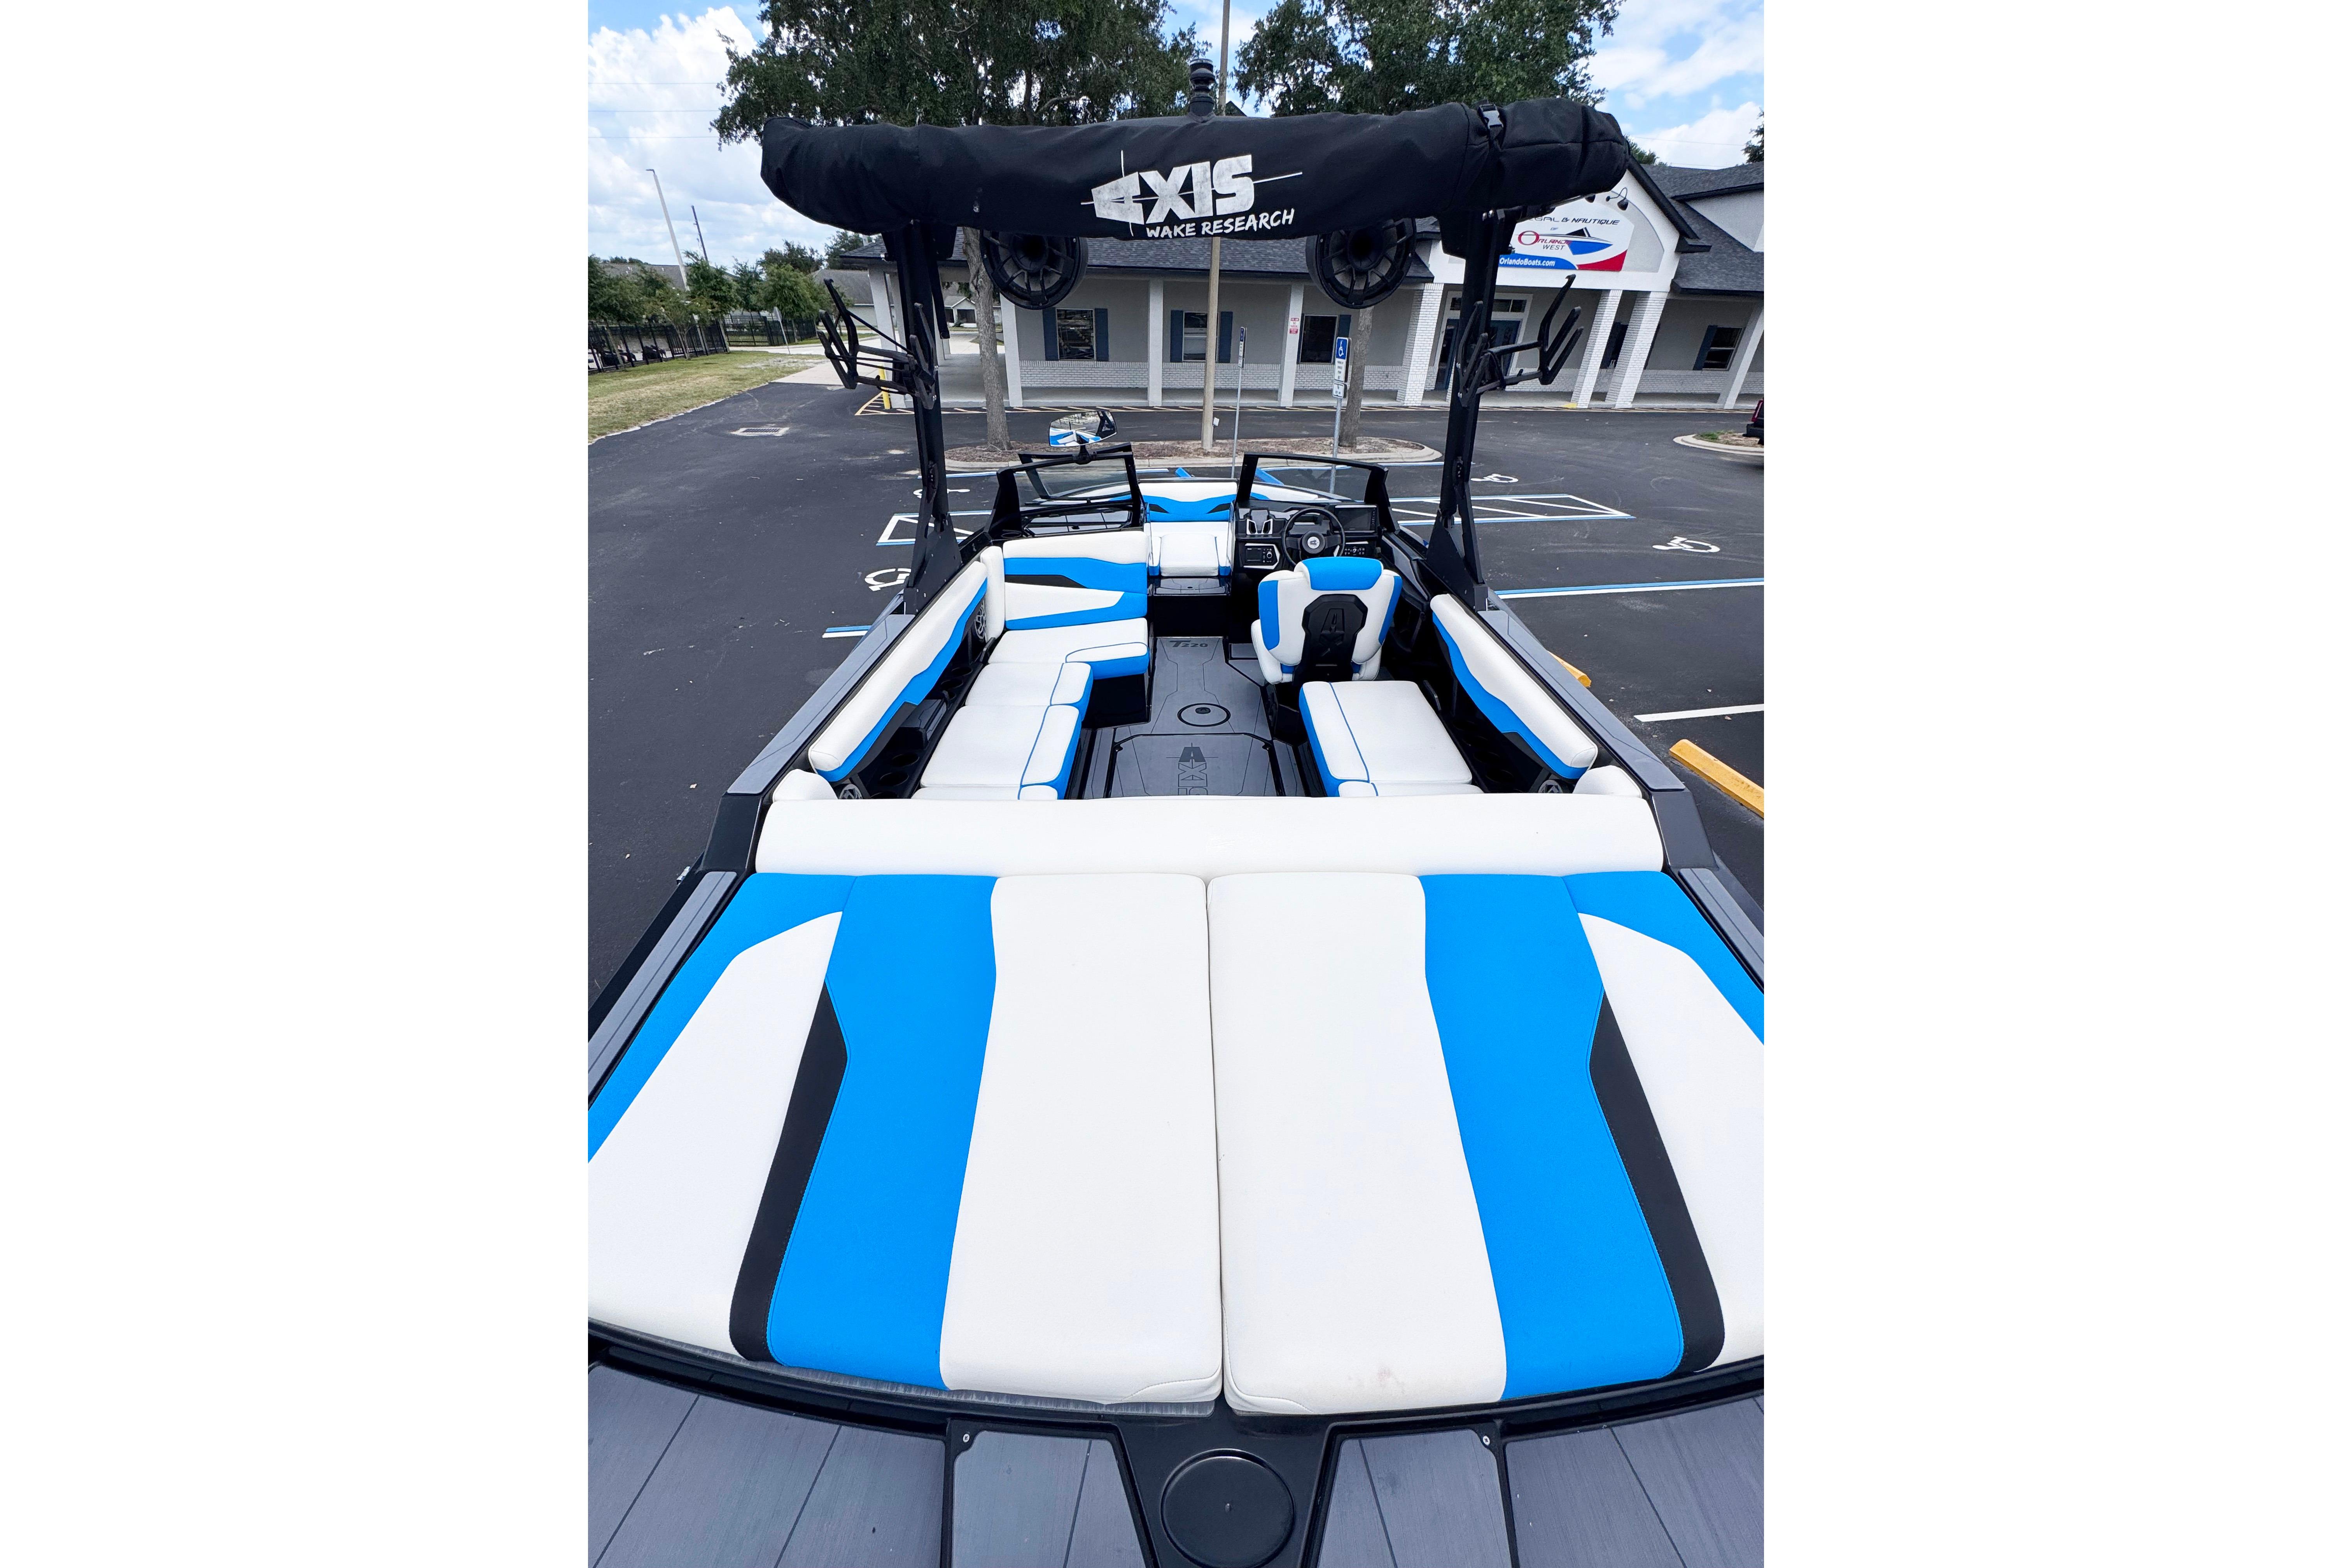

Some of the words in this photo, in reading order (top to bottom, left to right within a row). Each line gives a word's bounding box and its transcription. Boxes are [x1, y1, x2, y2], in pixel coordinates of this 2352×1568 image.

[1092, 154, 1254, 224] AXIS
[1146, 223, 1196, 238] WAKE
[1201, 208, 1295, 235] RESEARCH
[1499, 257, 1555, 267] OrlandoBoats.com
